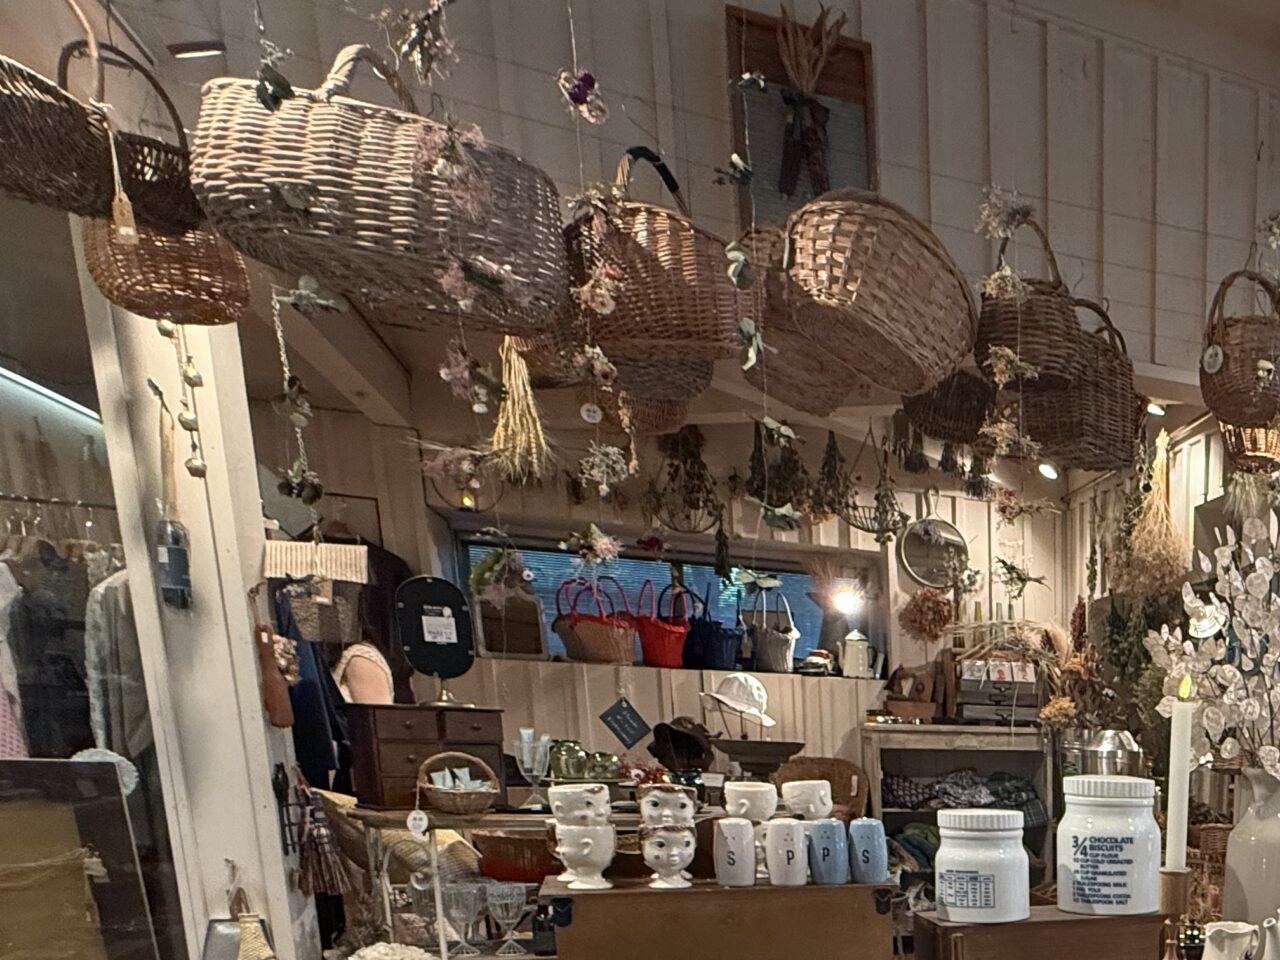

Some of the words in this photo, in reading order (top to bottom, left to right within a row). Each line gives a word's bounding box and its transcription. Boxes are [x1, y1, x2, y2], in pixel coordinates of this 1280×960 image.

[1089, 836, 1134, 845] CHOCOLATE
[1089, 844, 1124, 852] BISCUITS
[726, 850, 736, 866] S
[786, 849, 795, 865] P
[822, 847, 830, 862] P
[862, 849, 870, 864] S
